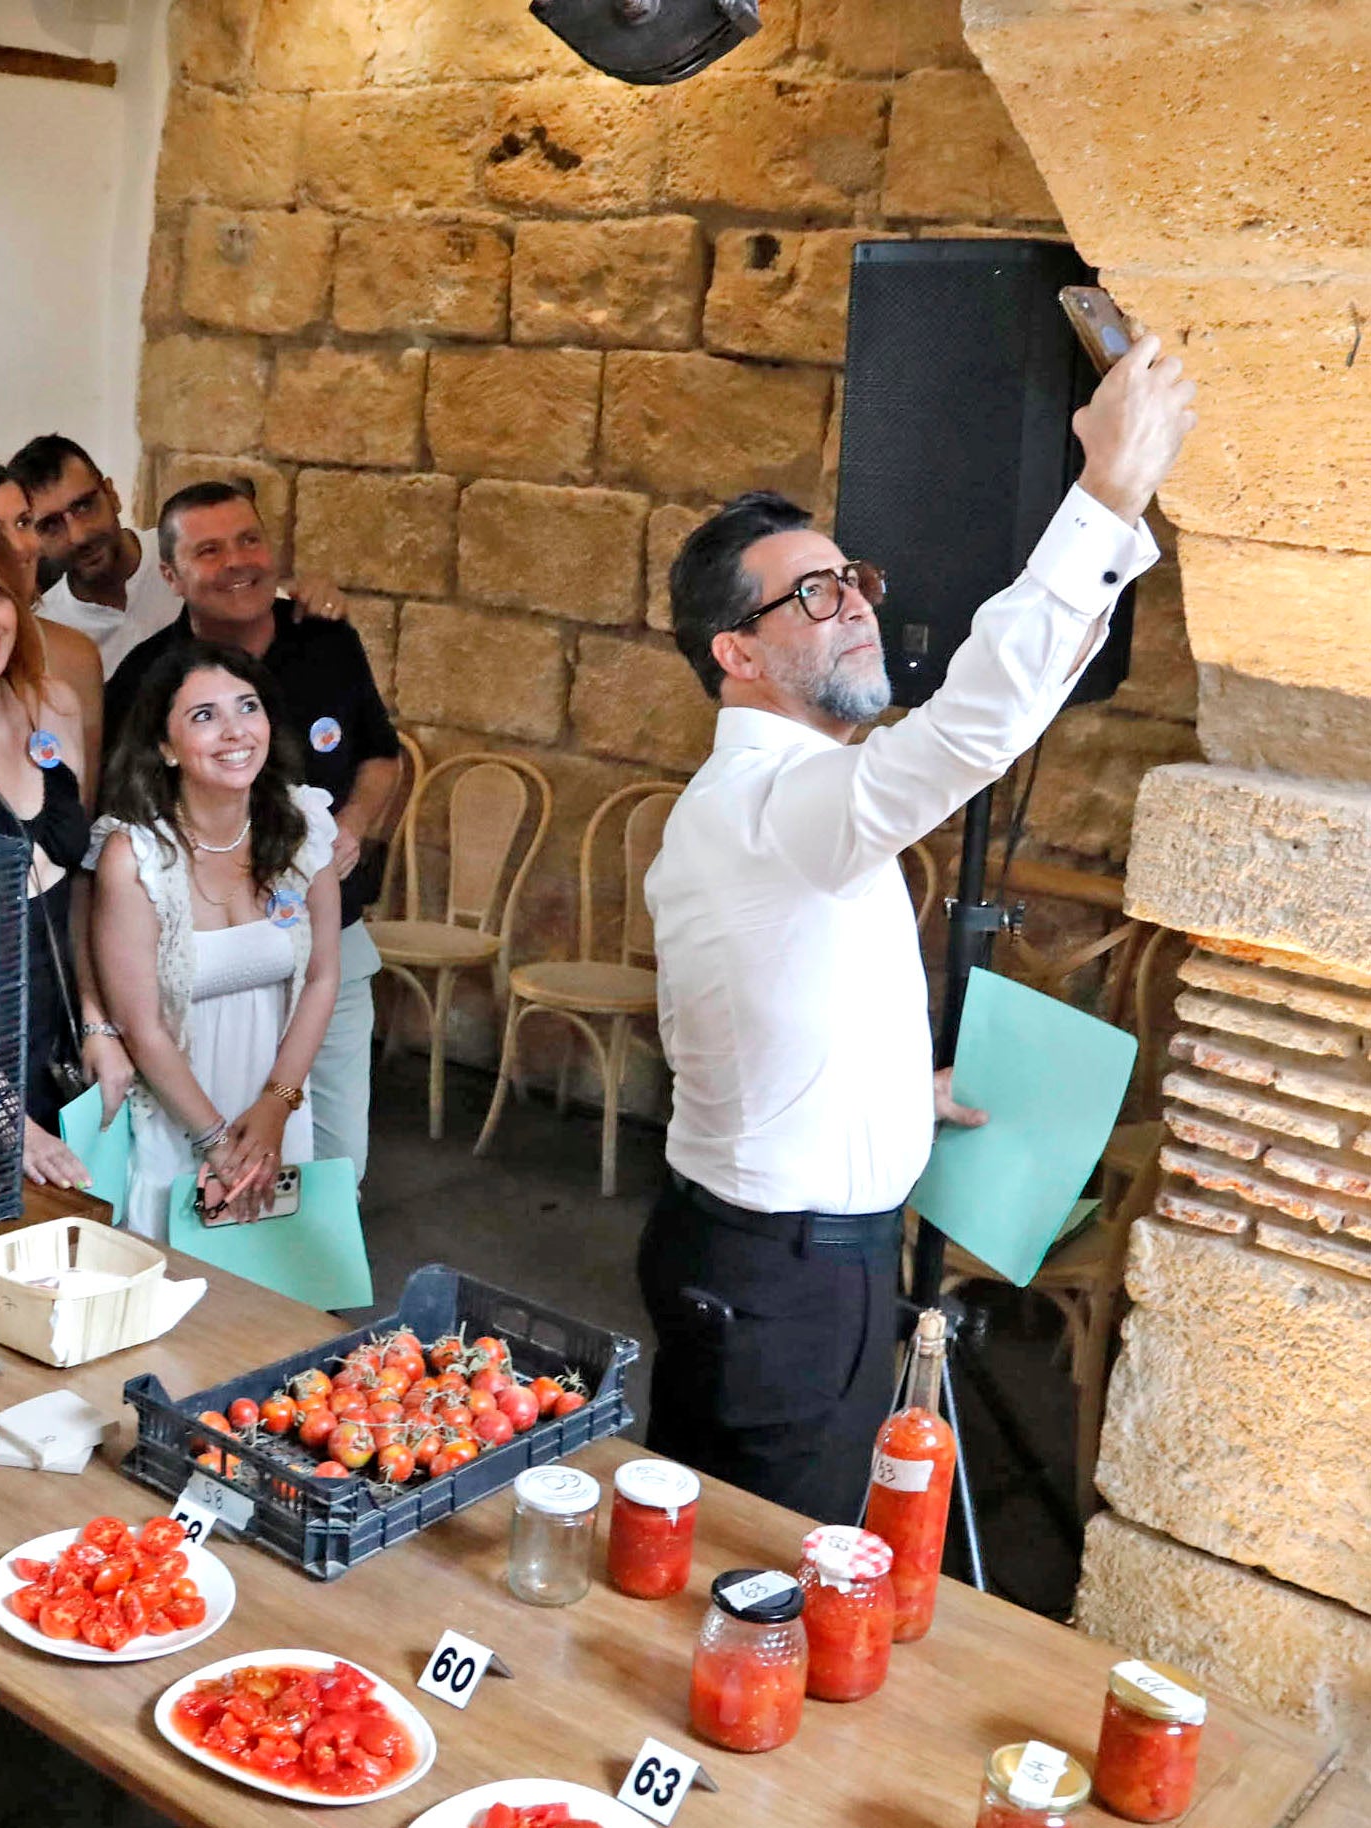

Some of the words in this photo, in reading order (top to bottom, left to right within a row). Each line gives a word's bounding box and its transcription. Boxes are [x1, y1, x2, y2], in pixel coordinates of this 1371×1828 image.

[203, 1480, 227, 1511] 58
[432, 1647, 476, 1693] 60
[634, 1756, 682, 1808] 63
